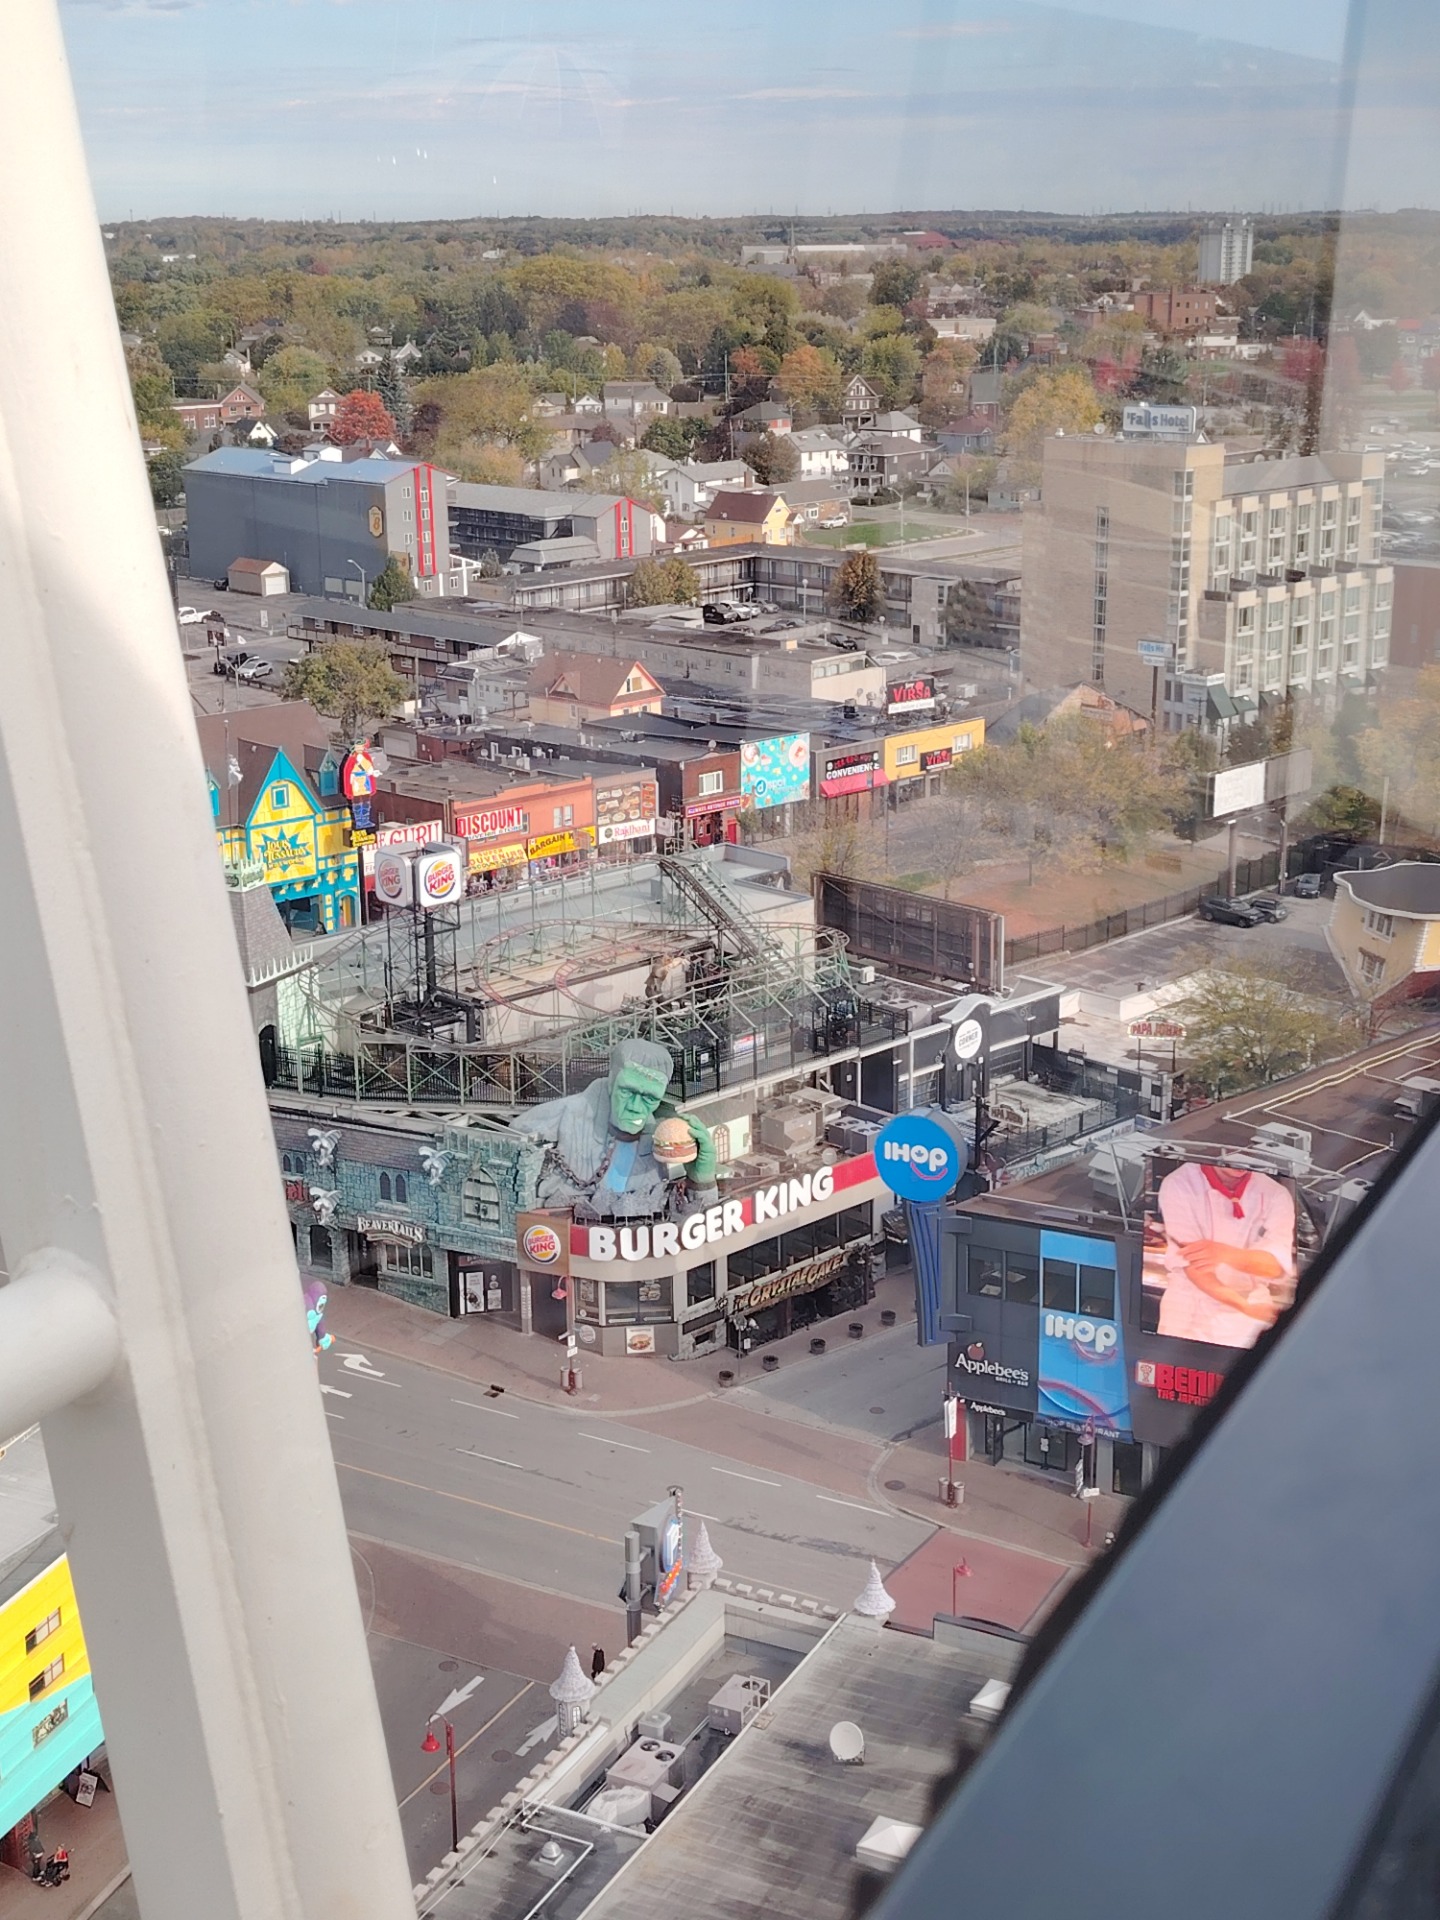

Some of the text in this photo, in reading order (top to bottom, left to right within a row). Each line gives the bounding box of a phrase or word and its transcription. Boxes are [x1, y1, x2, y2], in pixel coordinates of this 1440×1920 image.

[1160, 413, 1189, 427] Hotel
[373, 516, 380, 530] 8
[892, 685, 931, 702] VIRSA
[456, 806, 523, 838] DISCOUNT
[614, 824, 650, 837] Rajdhani
[530, 833, 566, 856] BARGAIN
[469, 849, 524, 866] OUVENIRS
[428, 864, 453, 884] BURGER
[429, 871, 455, 893] KING
[884, 1141, 948, 1172] IHOP
[588, 1166, 834, 1262] BURGER KING
[527, 1234, 554, 1246] BURGER
[529, 1240, 556, 1254] KING
[749, 1267, 807, 1307] CRYSTAL
[1045, 1314, 1118, 1353] IHOP
[955, 1353, 1029, 1382] Applebee's
[1156, 1362, 1224, 1398] BENI
[1157, 1388, 1175, 1401] THE
[1066, 1422, 1121, 1439] RESTARANT
